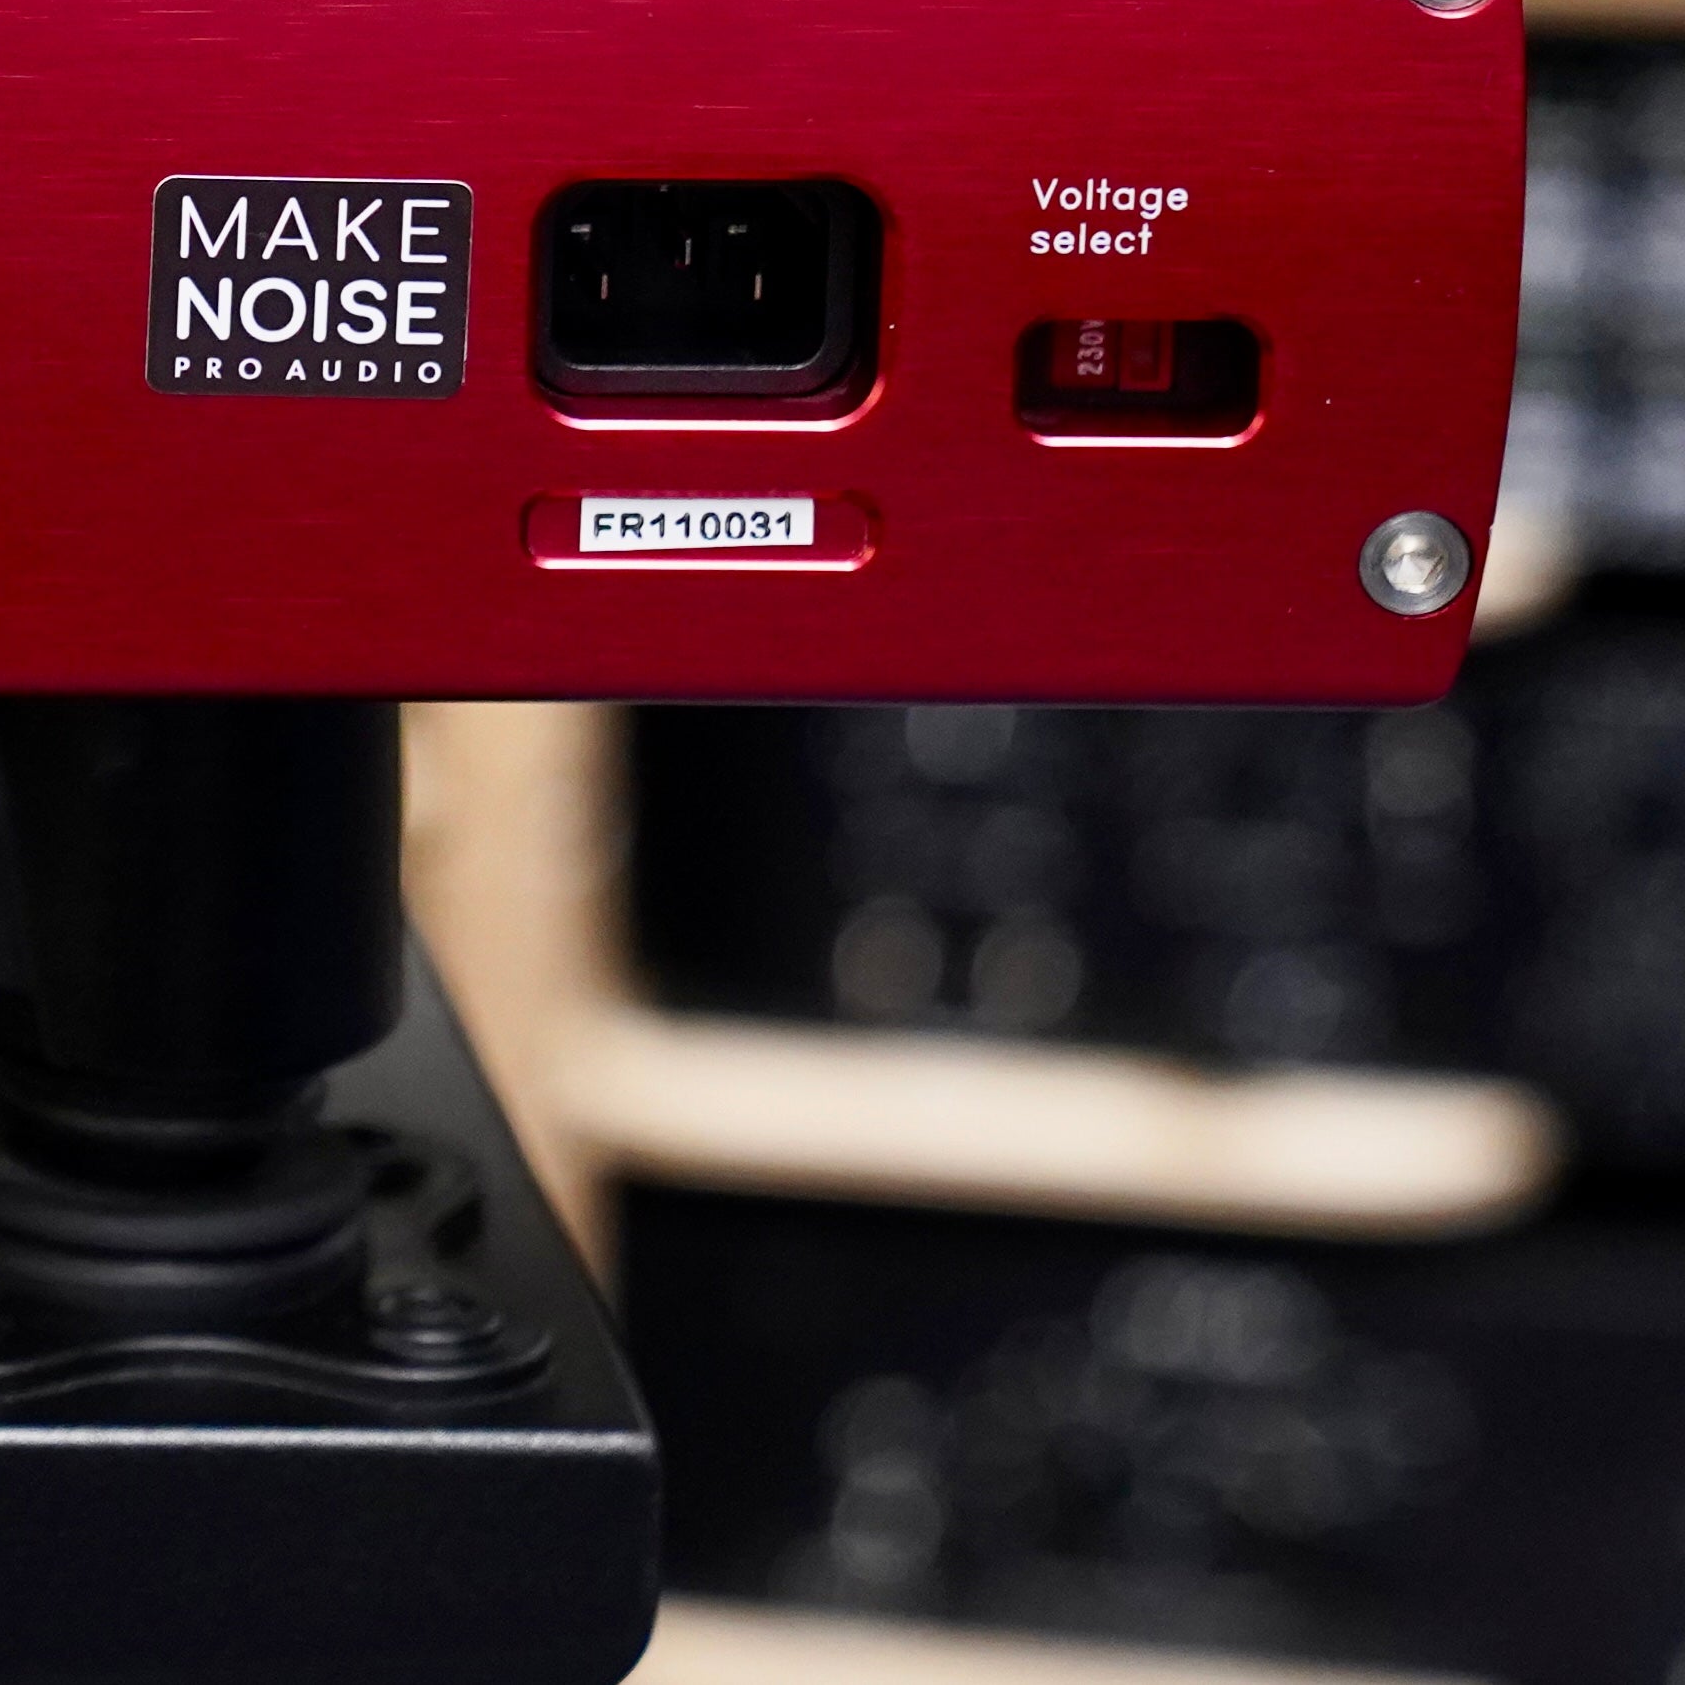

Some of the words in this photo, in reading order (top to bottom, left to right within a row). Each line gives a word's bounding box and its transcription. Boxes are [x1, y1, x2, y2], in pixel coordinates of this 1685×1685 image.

[1032, 178, 1189, 220] Voltage
[179, 195, 451, 265] MAKE
[1030, 222, 1153, 255] select
[175, 275, 448, 347] NOISE
[174, 356, 263, 381] PRO
[284, 358, 443, 385] AUDIO
[592, 510, 793, 542] FR110031
